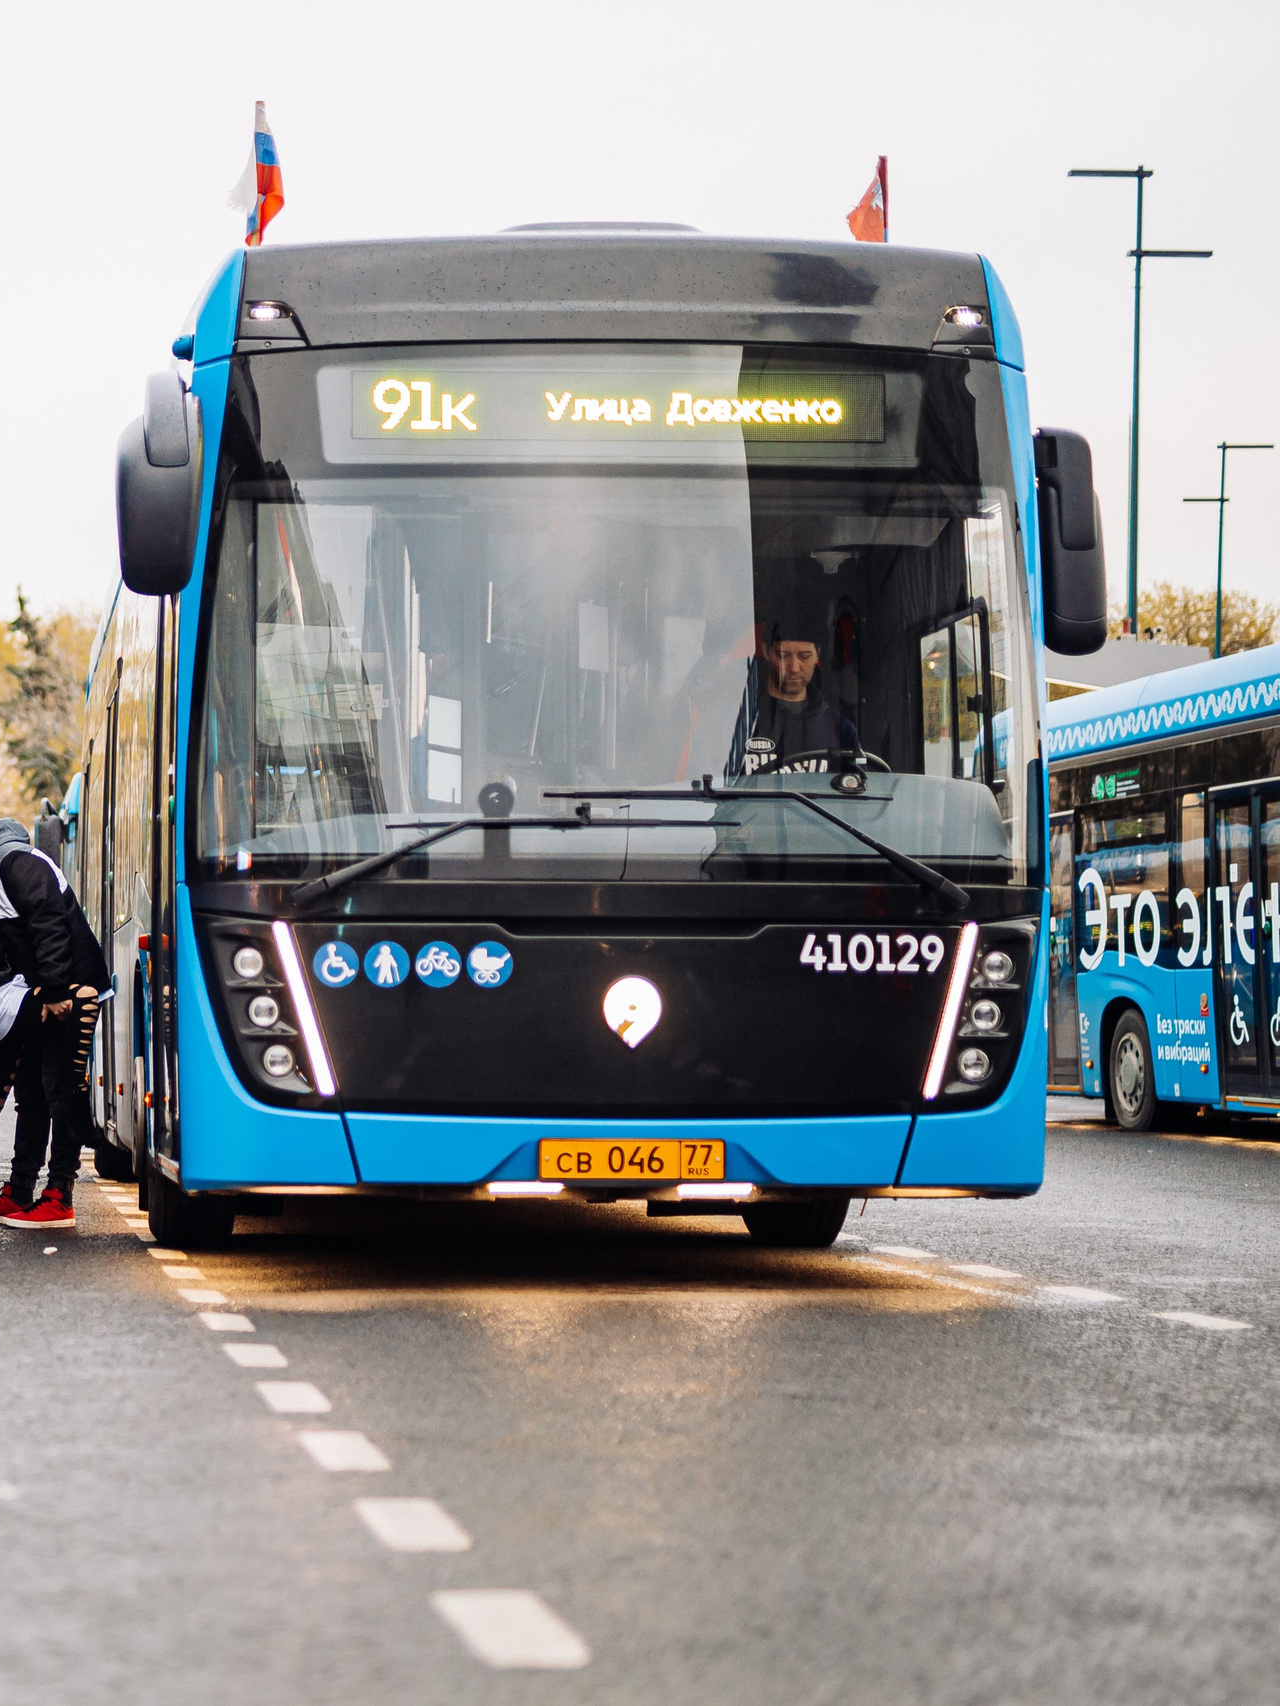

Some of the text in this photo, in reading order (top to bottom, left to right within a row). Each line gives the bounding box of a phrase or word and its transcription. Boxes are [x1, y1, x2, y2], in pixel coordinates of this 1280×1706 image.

[544, 390, 843, 427] Улица Довженко
[1078, 867, 1160, 970] Это
[799, 934, 945, 973] 410129
[1157, 1013, 1206, 1039] Без тряски
[1158, 1040, 1211, 1065] и вибраций
[608, 1146, 664, 1173] 046
[685, 1144, 713, 1166] 77
[688, 1167, 710, 1176] RUS
